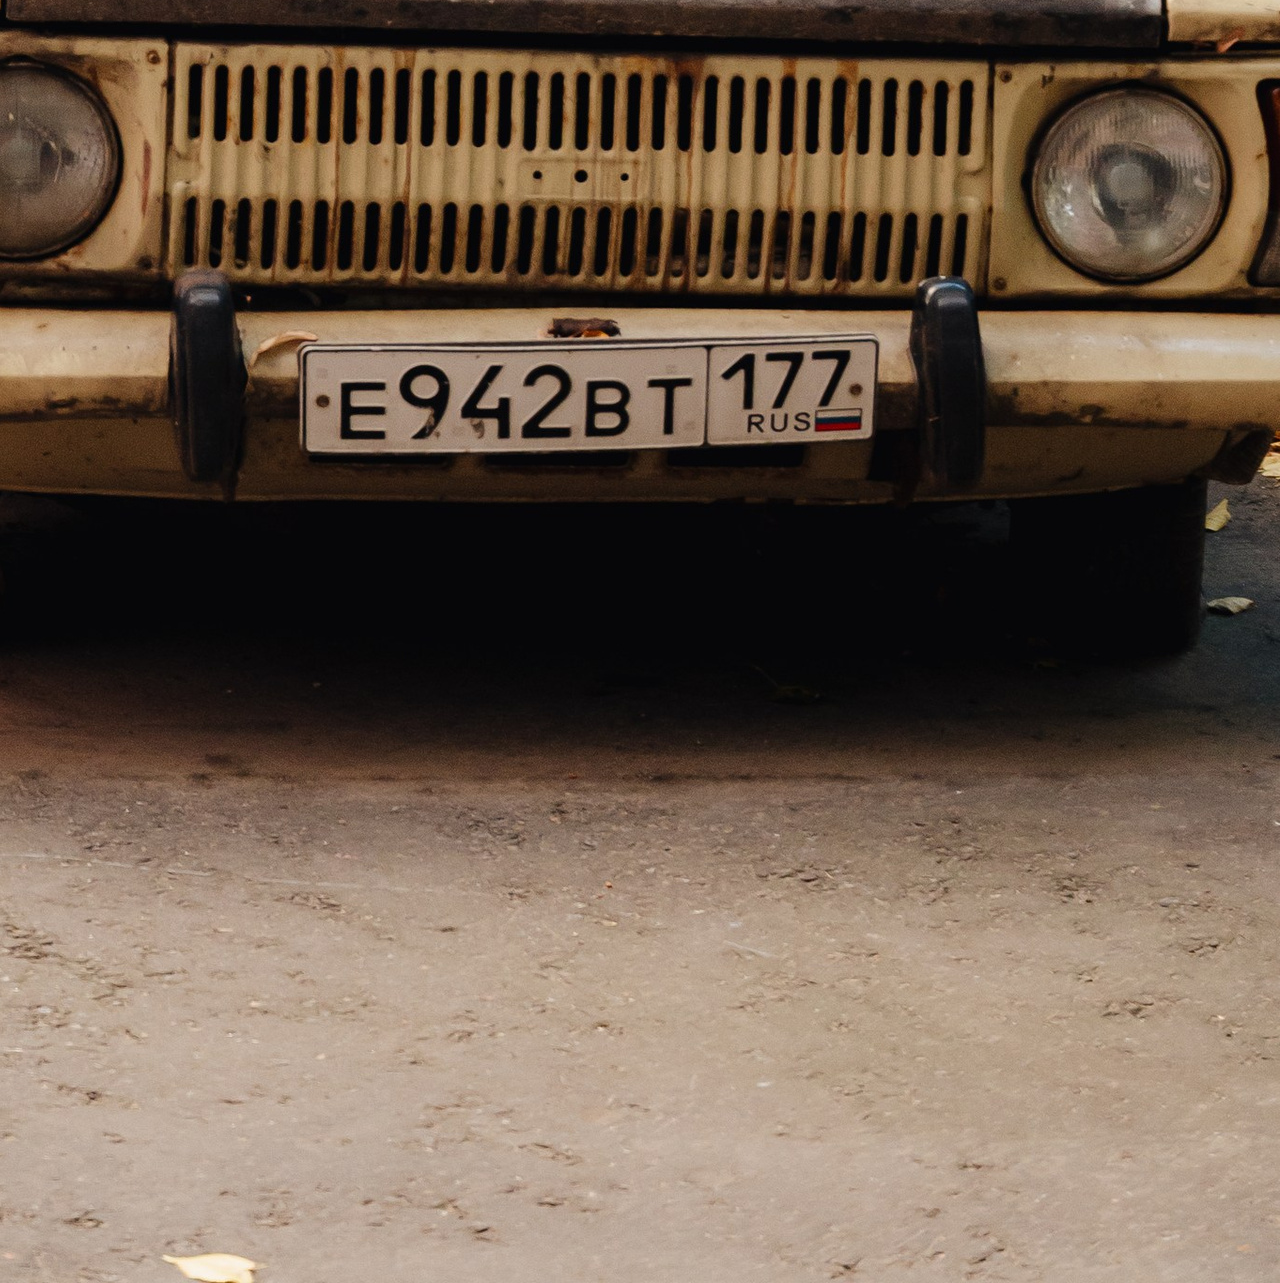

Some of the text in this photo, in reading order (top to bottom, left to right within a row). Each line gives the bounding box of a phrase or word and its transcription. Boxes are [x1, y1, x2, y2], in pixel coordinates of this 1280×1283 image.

[339, 349, 852, 440] E942BT 177
[747, 411, 812, 434] RUS
